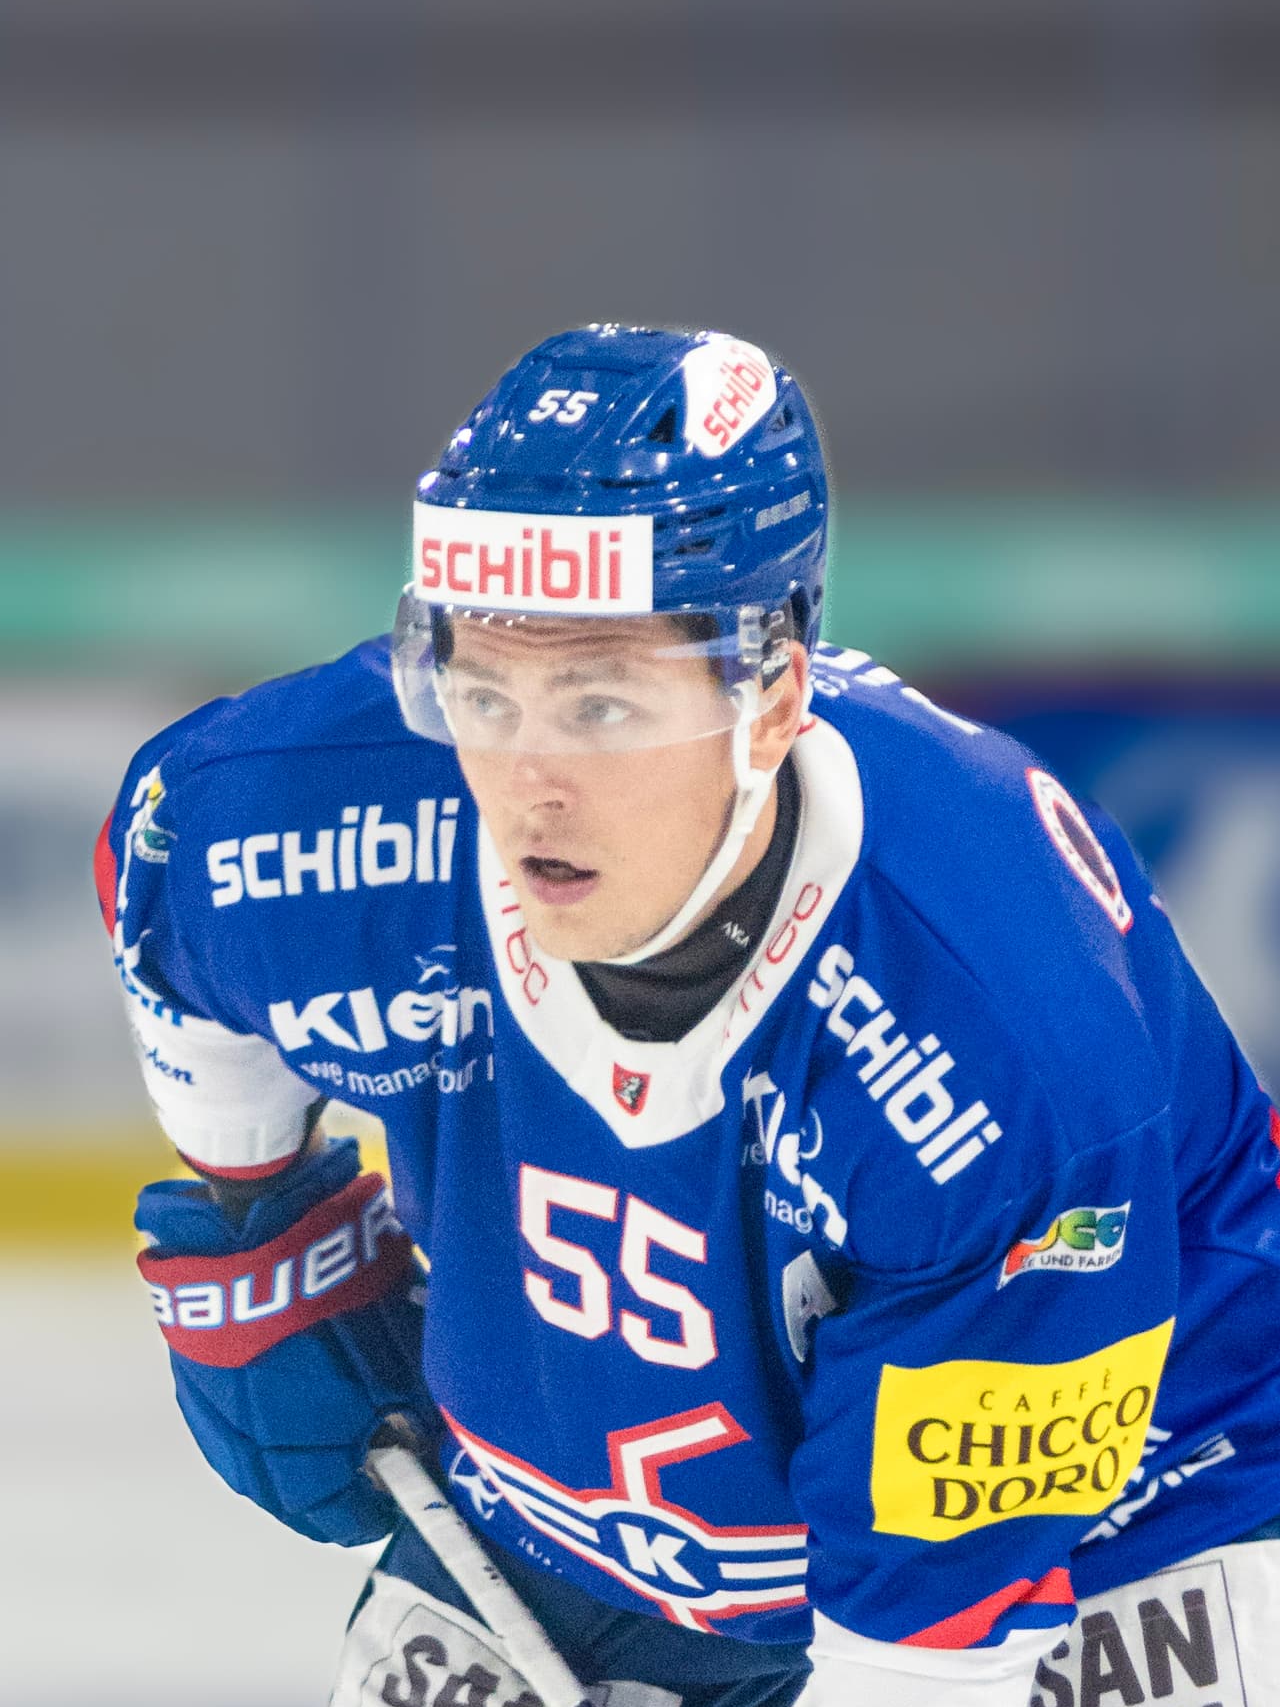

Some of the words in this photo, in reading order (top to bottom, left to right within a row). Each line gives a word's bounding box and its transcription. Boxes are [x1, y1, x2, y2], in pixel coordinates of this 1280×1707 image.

[528, 389, 599, 424] 55
[519, 1161, 719, 1371] 55
[1039, 1253, 1075, 1268] UND
[977, 1367, 1113, 1414] CAFFÈ
[905, 1383, 1153, 1469] CHICCO
[930, 1444, 1122, 1522] D'ORO
